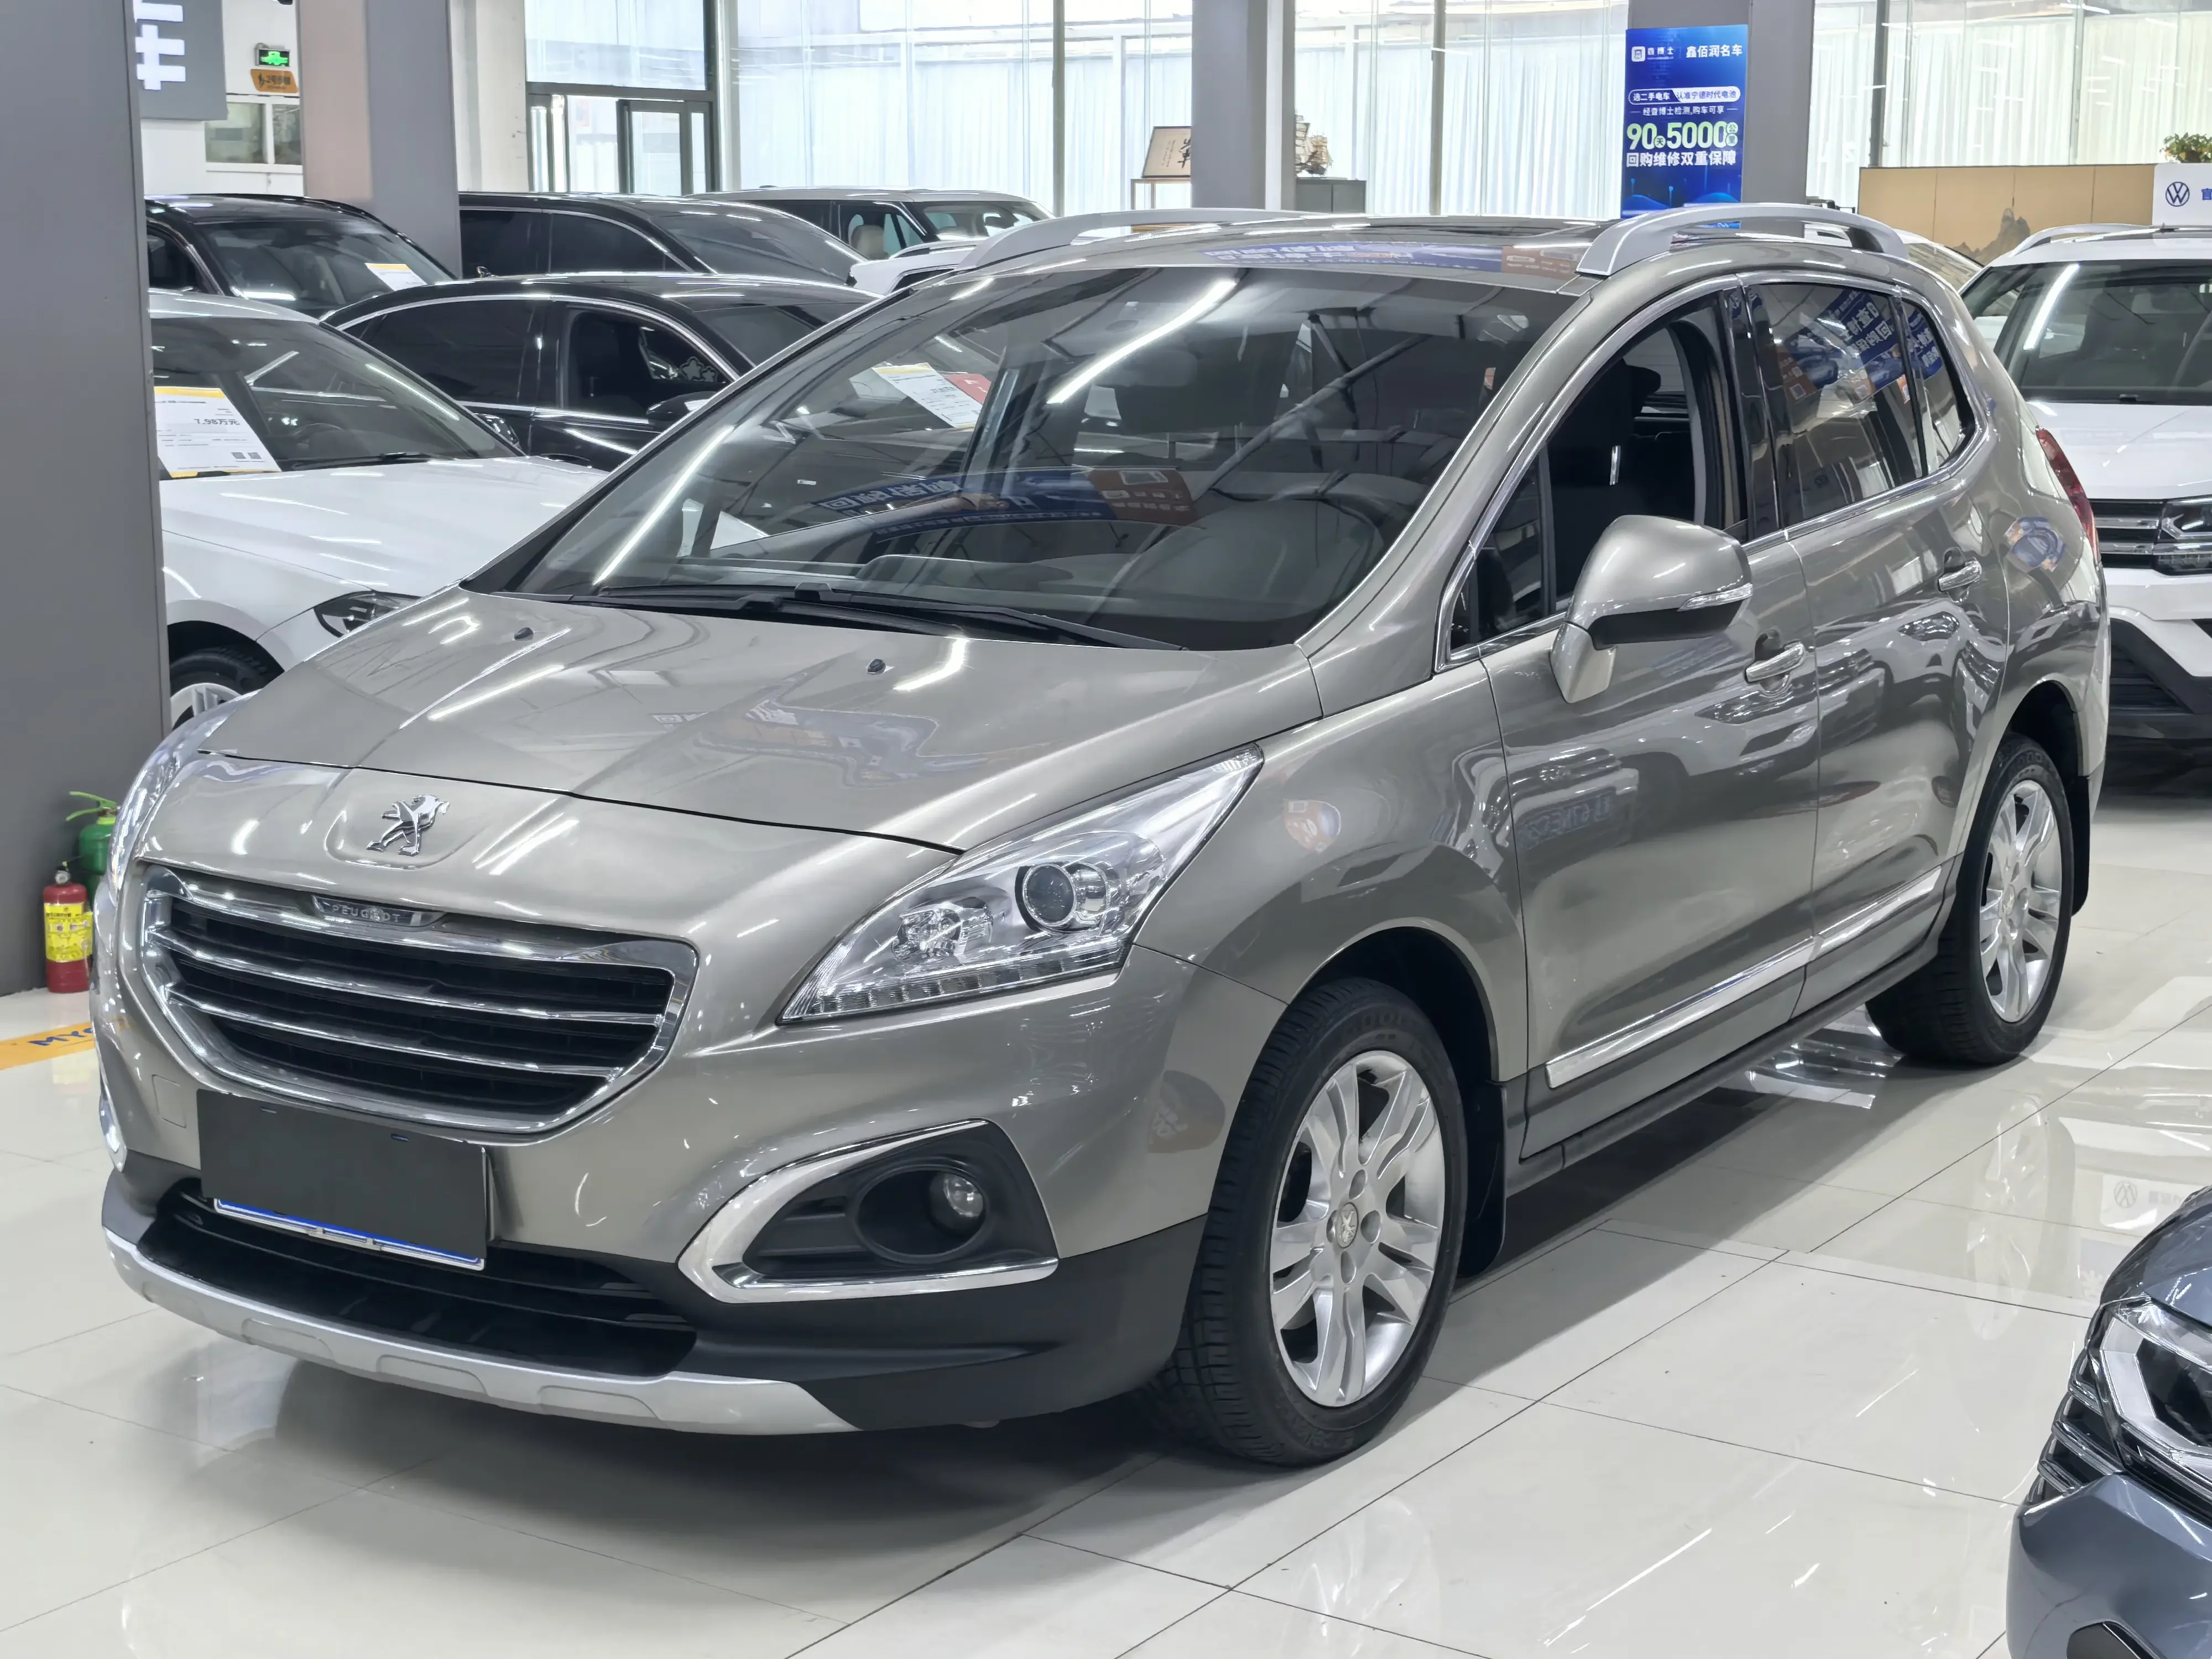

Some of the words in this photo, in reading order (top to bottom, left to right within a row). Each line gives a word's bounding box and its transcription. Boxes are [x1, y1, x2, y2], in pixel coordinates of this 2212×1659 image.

[1686, 44, 1743, 58] 鑫佰润名车
[1626, 150, 1736, 168] 回购维修双重保障
